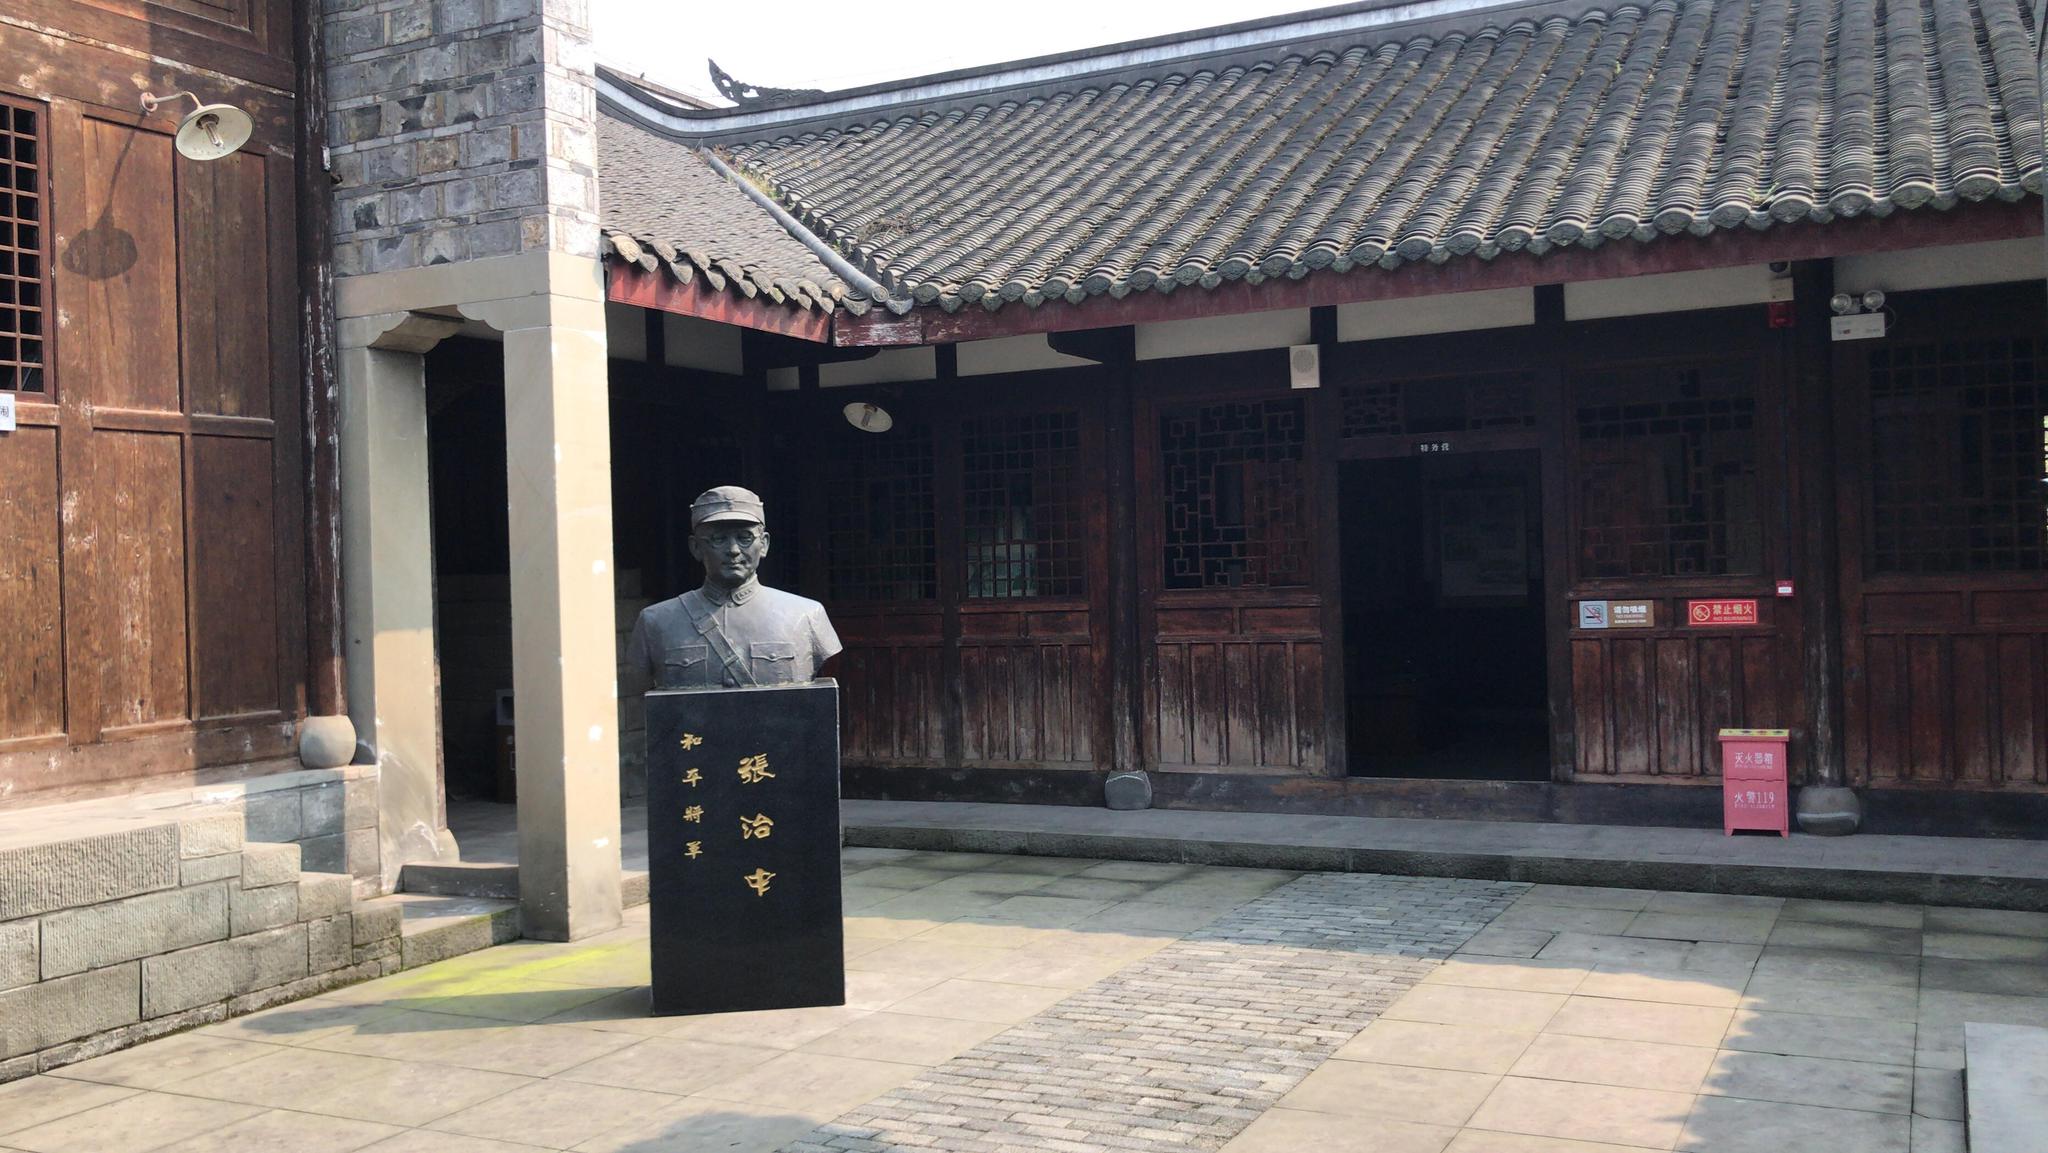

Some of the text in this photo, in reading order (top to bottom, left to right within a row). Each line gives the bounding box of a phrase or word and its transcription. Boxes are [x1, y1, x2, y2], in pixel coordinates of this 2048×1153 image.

[1712, 603, 1753, 615] 禁止烟火
[1735, 752, 1774, 765] 灭火器箱
